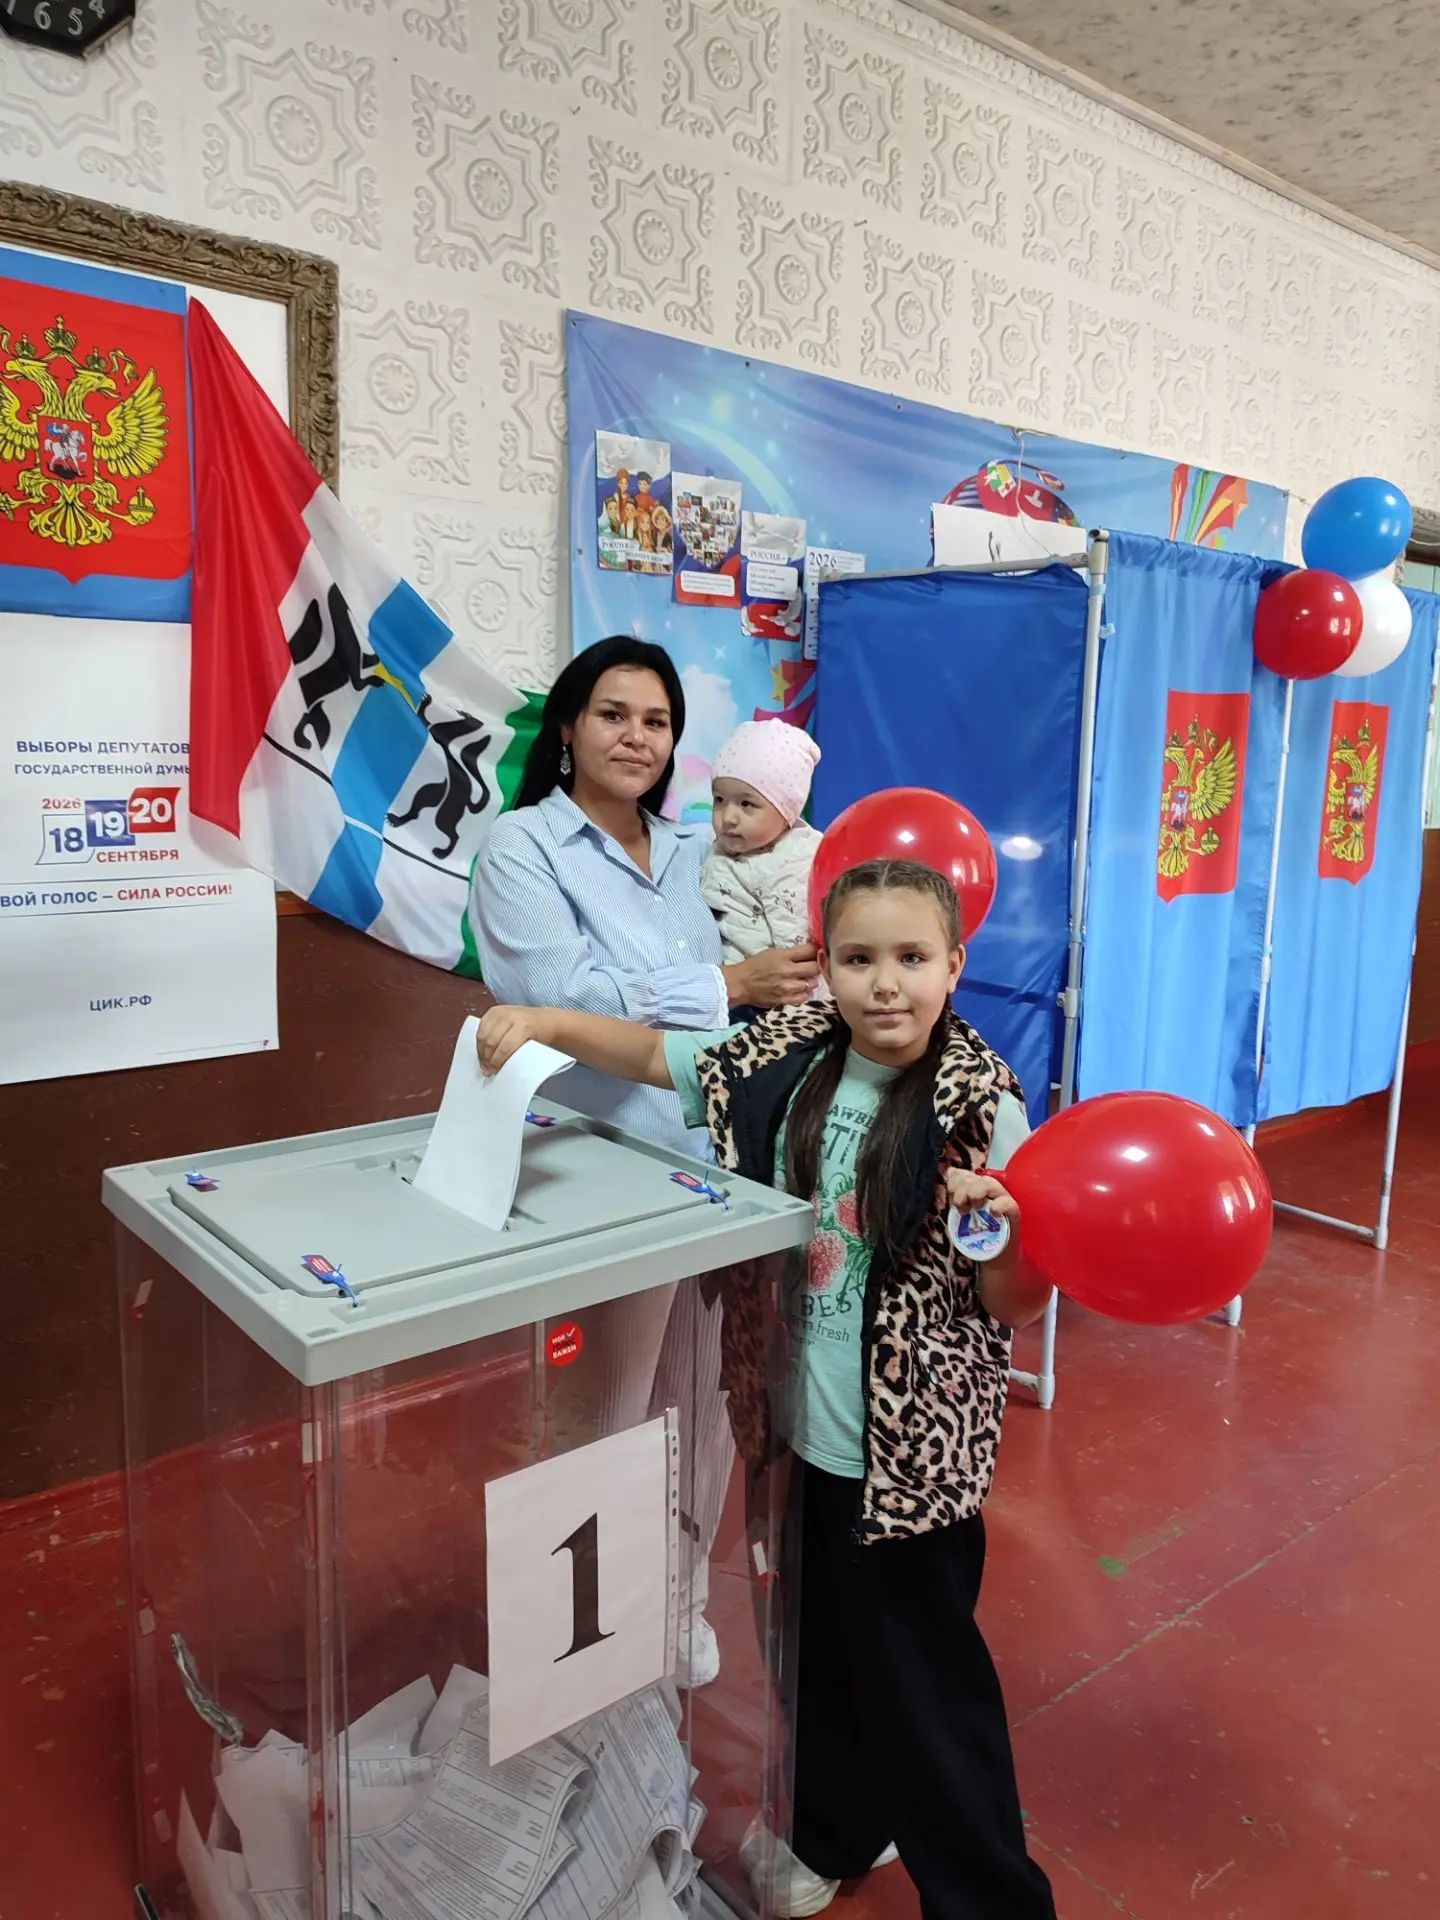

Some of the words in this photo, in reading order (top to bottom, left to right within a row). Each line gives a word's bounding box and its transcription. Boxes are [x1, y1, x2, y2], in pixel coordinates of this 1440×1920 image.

[33, 1, 52, 30] 6
[67, 7, 83, 35] 5
[809, 551, 837, 568] 2026
[16, 741, 92, 753] ВЫБОРЫ
[97, 742, 190, 754] ДЕПУТАТОВ
[15, 763, 153, 775] ГОСУДАРСТВЕННОЙ
[42, 798, 82, 809] 2026
[49, 827, 84, 853] 18
[90, 811, 125, 837] 19
[130, 797, 172, 823] 20
[96, 849, 179, 863] СЕНТЯБРЯ
[41, 891, 98, 905] ГОЛОС
[117, 887, 160, 901] СИЛА
[165, 884, 233, 899] РОССИИ!
[89, 995, 152, 1011] ЦИК.РФ
[816, 1321, 850, 1342] fresh
[551, 1512, 615, 1663] 1
